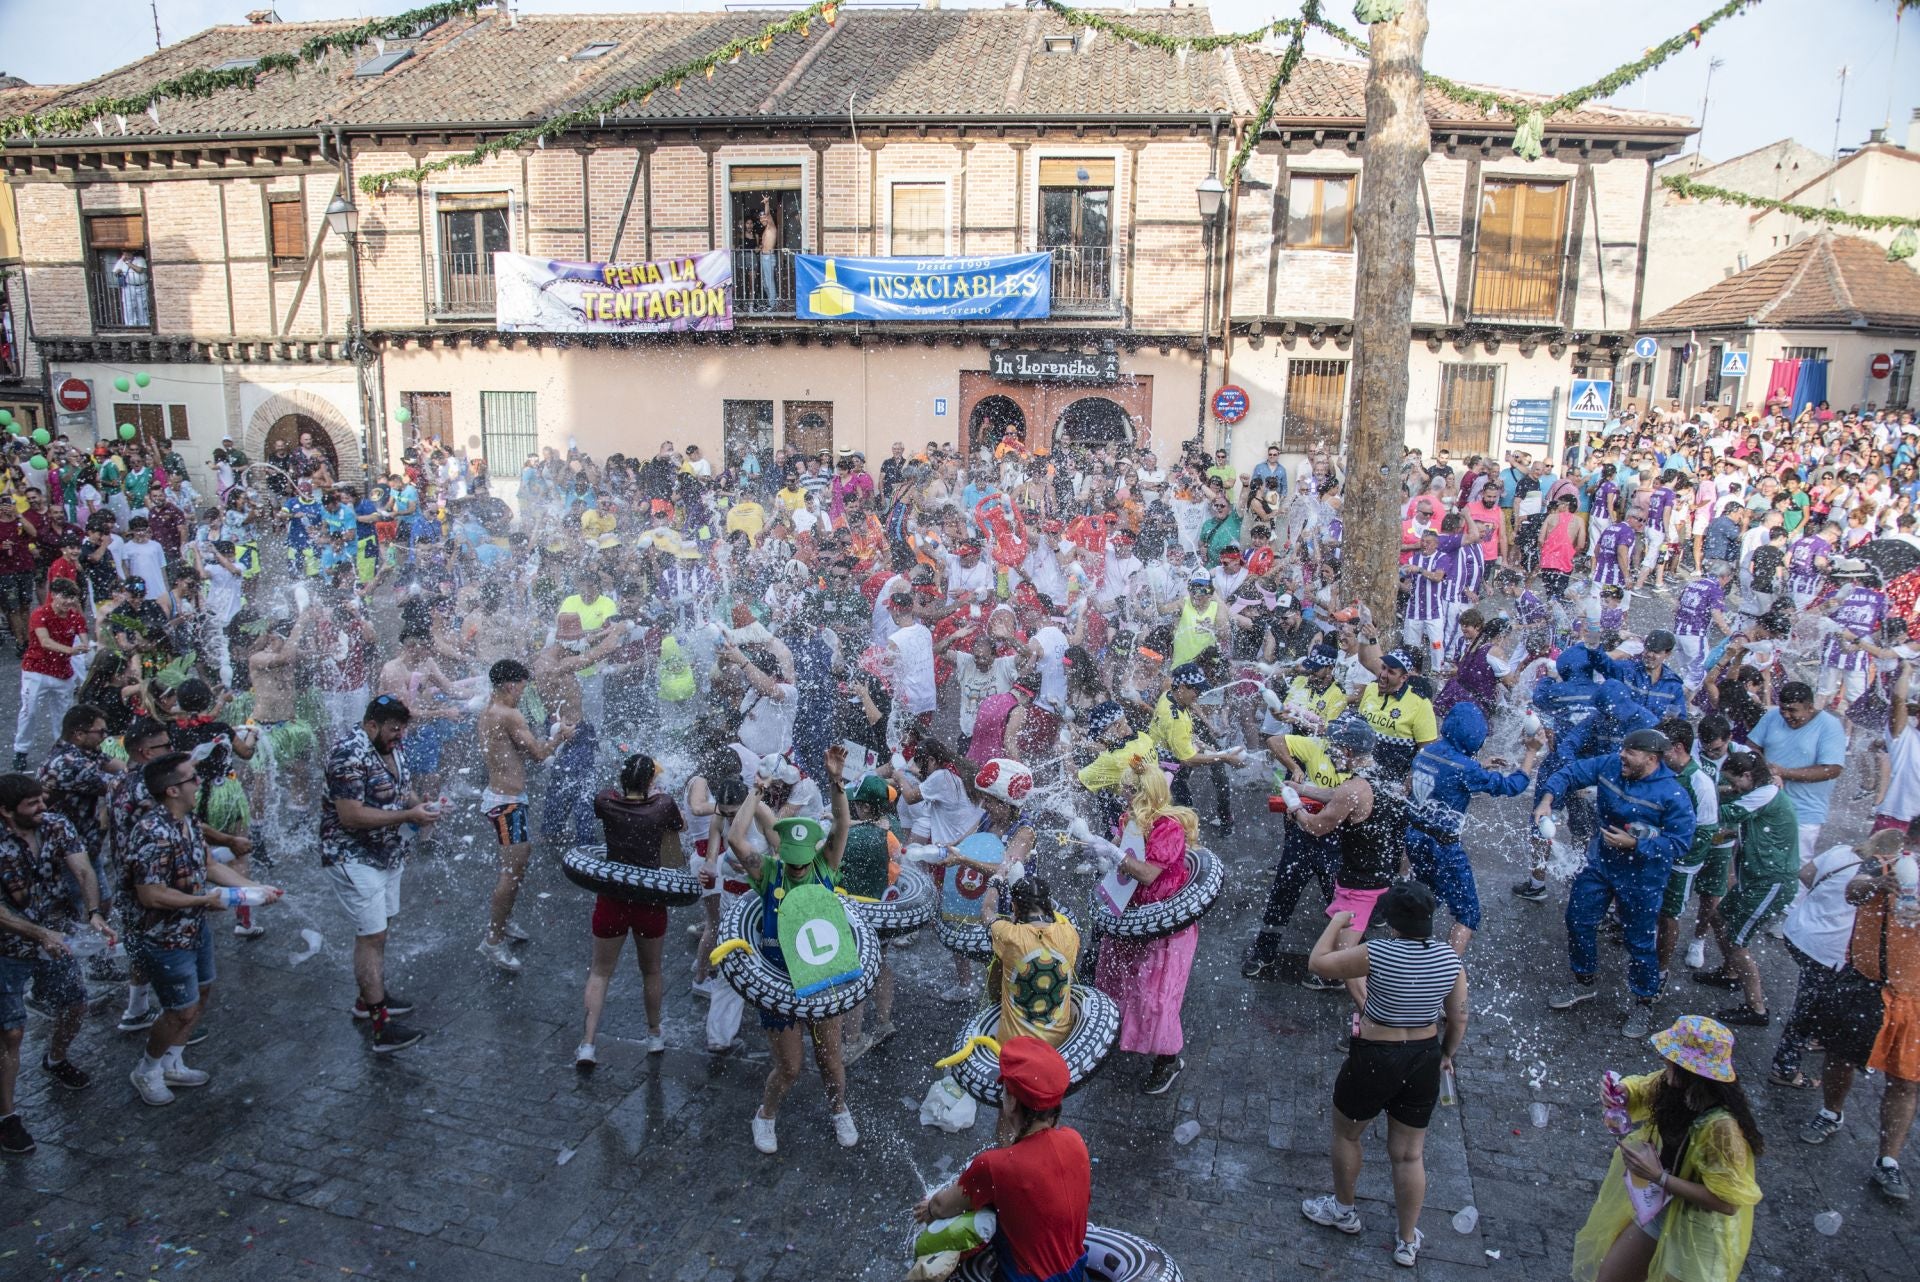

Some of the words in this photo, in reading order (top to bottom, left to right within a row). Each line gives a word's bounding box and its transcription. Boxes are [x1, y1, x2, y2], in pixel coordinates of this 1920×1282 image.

[670, 258, 697, 281] LA
[917, 261, 953, 271] Desde
[960, 260, 991, 270] 1999
[868, 273, 1038, 300] INSACIABLES
[582, 281, 725, 320] TENTACIÓN
[913, 305, 936, 315] San
[1016, 354, 1098, 376] Lorencho
[1105, 355, 1117, 379] BAR
[1315, 771, 1340, 788] POLI
[796, 826, 803, 838] L
[805, 927, 834, 957] L
